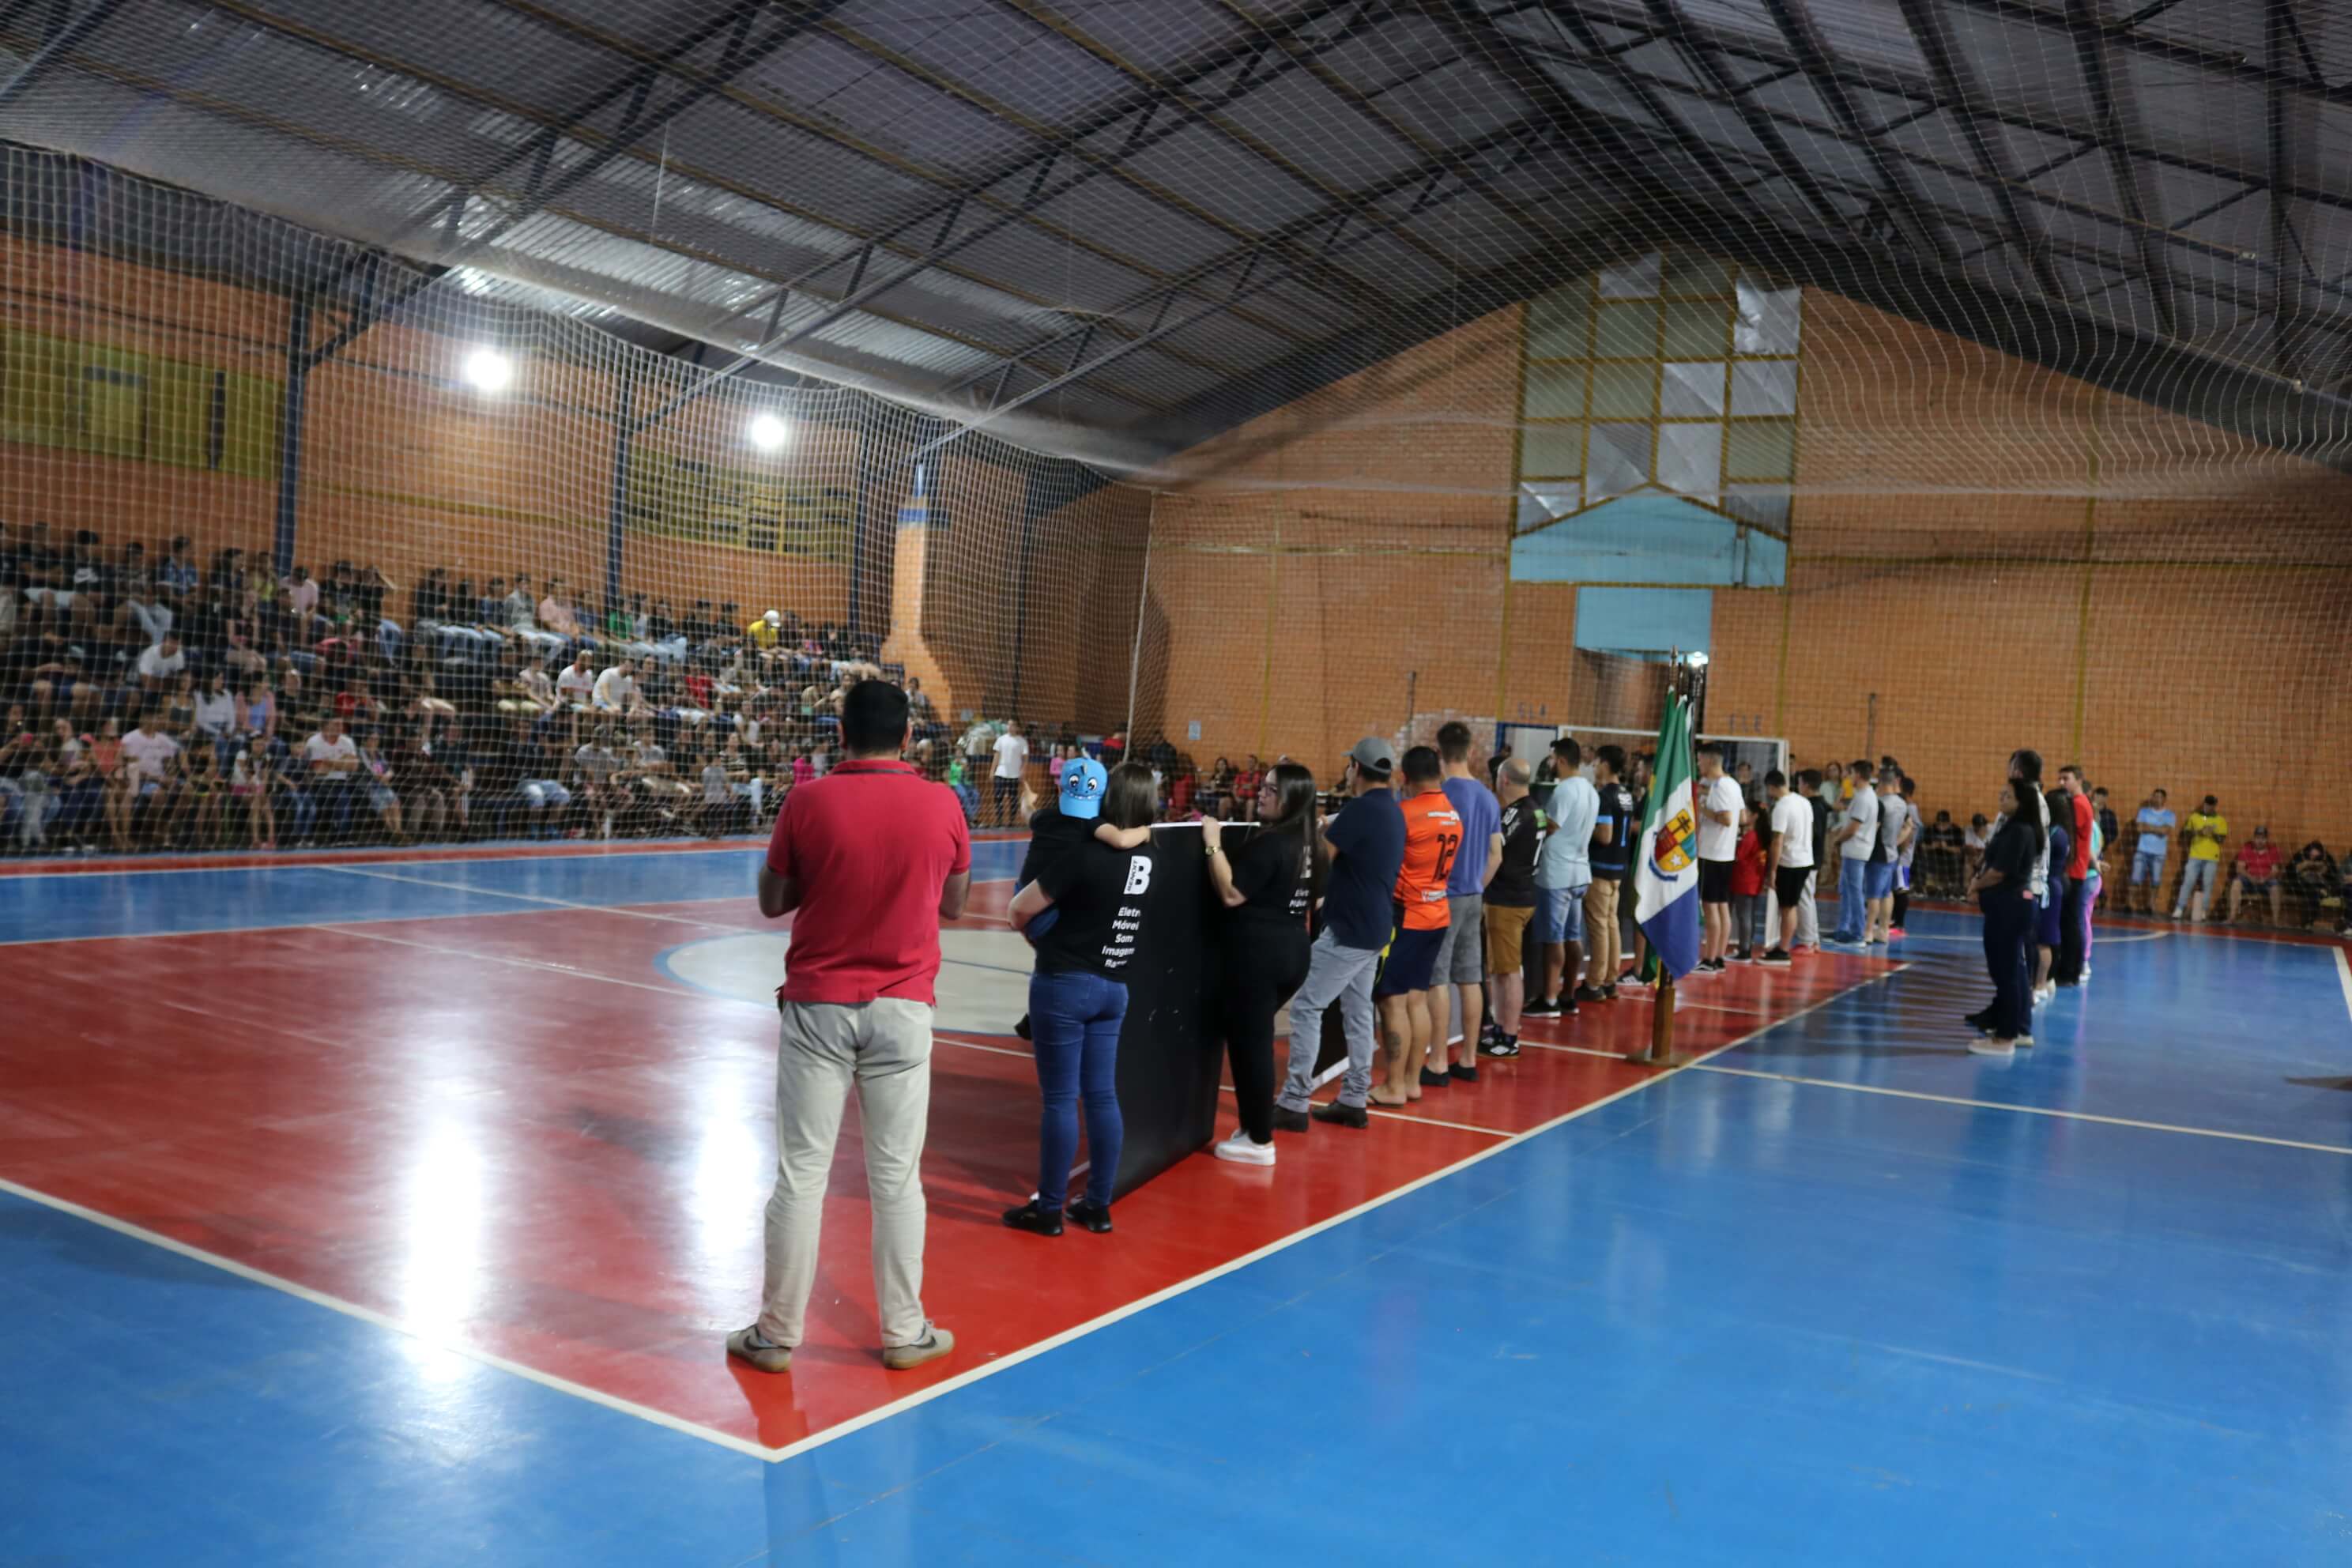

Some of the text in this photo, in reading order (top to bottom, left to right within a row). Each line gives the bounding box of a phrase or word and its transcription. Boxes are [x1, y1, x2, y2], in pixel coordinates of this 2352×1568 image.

[1432, 835, 1457, 882] 12
[1124, 856, 1152, 895] B
[1101, 945, 1136, 958] Imagem
[1114, 933, 1134, 944] Som
